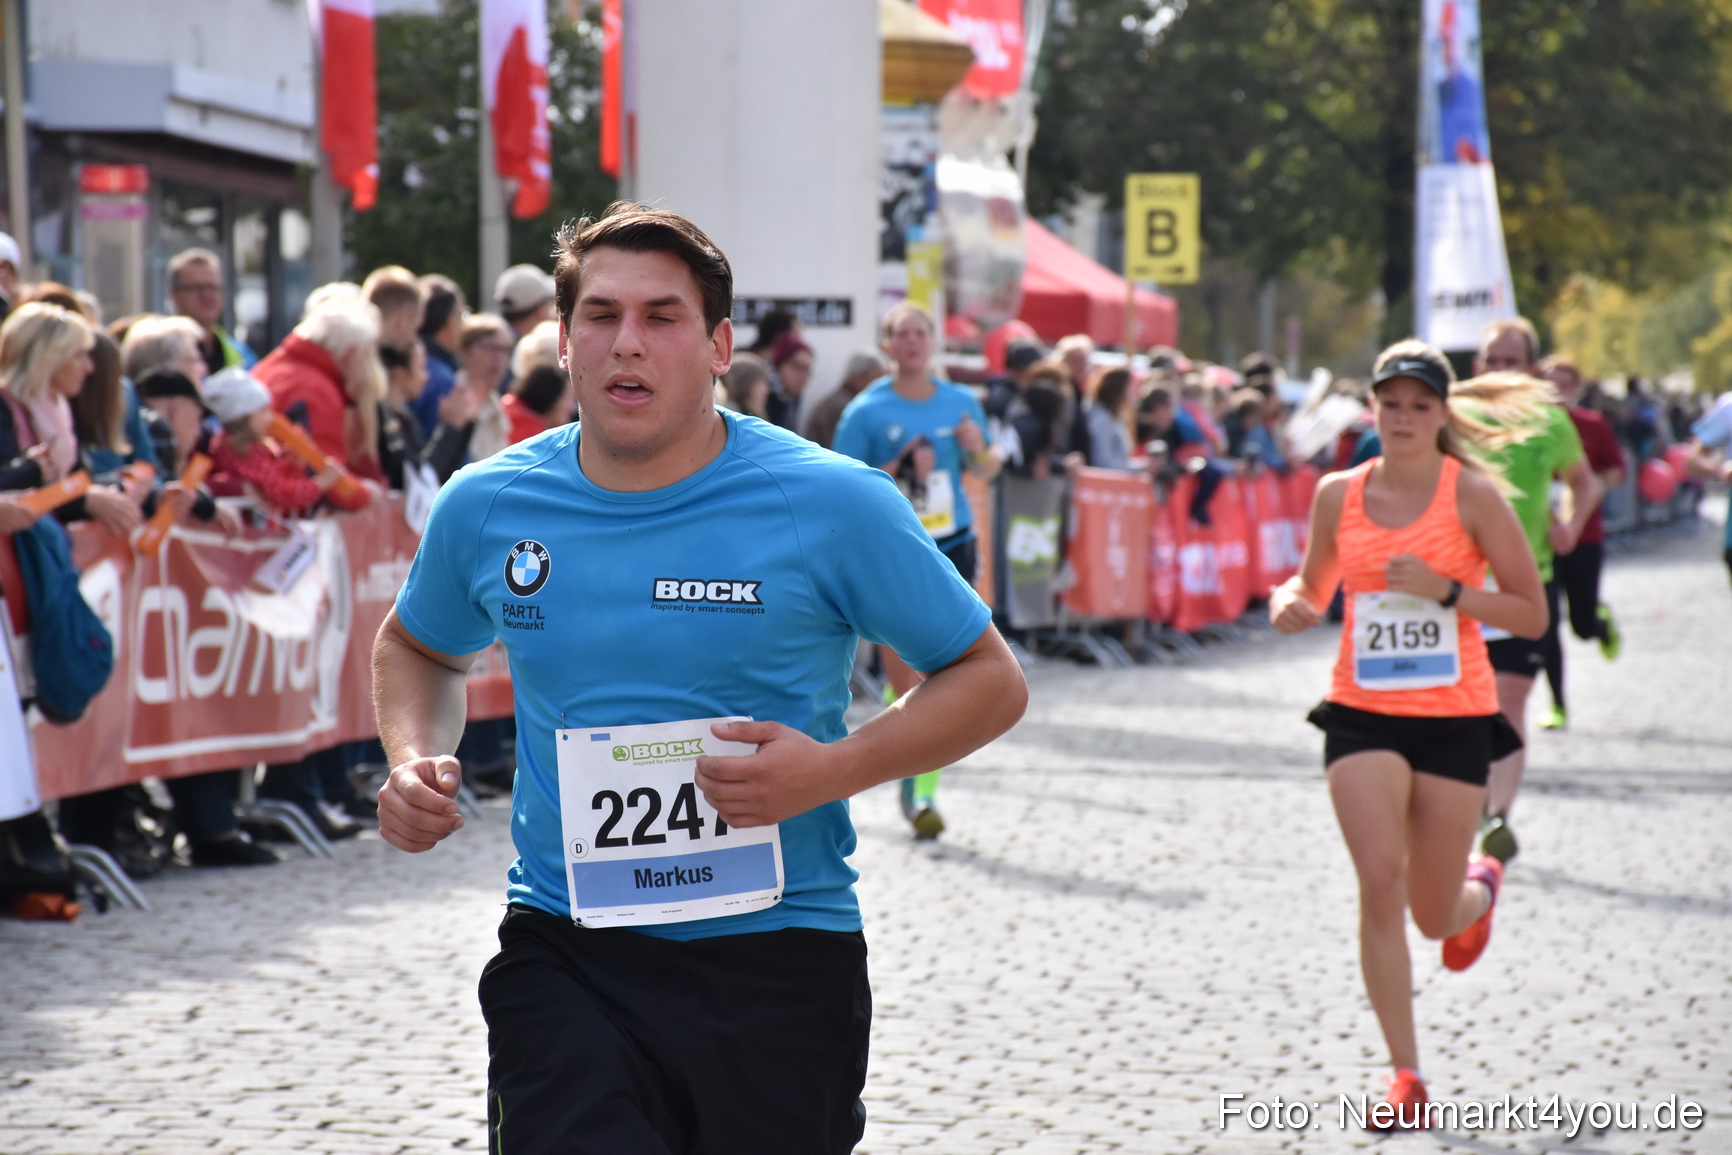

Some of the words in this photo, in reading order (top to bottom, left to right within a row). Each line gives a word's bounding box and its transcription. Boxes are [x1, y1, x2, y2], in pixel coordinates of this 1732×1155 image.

[1147, 210, 1178, 257] B
[510, 541, 539, 562] BMW
[654, 579, 761, 604] BOCK
[502, 603, 545, 620] PARTL
[650, 602, 683, 612] inspired
[685, 604, 695, 613] by
[697, 605, 723, 613] smart
[725, 607, 766, 616] concepts
[503, 618, 545, 631] Neumarkt
[1367, 620, 1441, 651] 2159
[631, 738, 705, 760] BOCK
[633, 759, 655, 767] inspired
[575, 843, 583, 854] D
[634, 865, 714, 889] Markus
